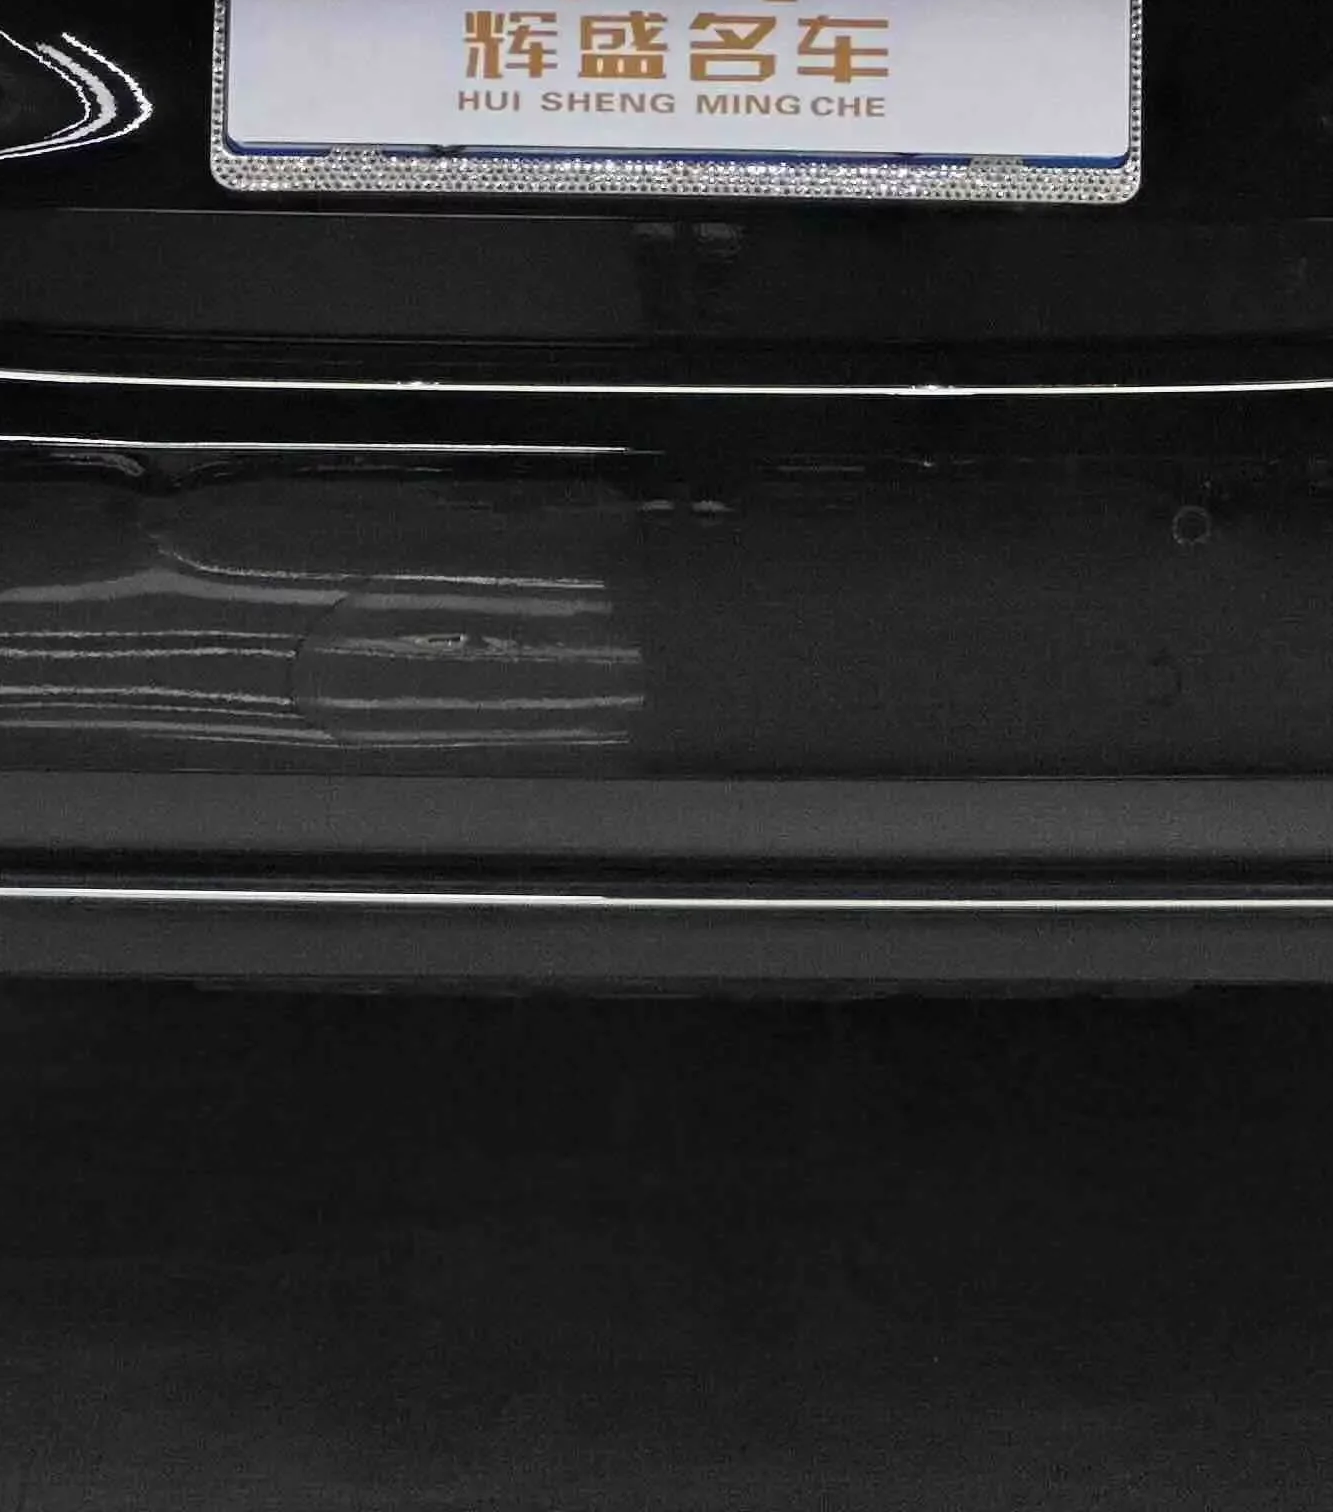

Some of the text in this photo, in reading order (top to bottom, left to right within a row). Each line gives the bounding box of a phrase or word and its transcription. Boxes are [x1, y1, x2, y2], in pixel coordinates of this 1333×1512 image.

[464, 10, 889, 83] 辉盛名车
[457, 90, 886, 118] HUI SHENG MING CHE
